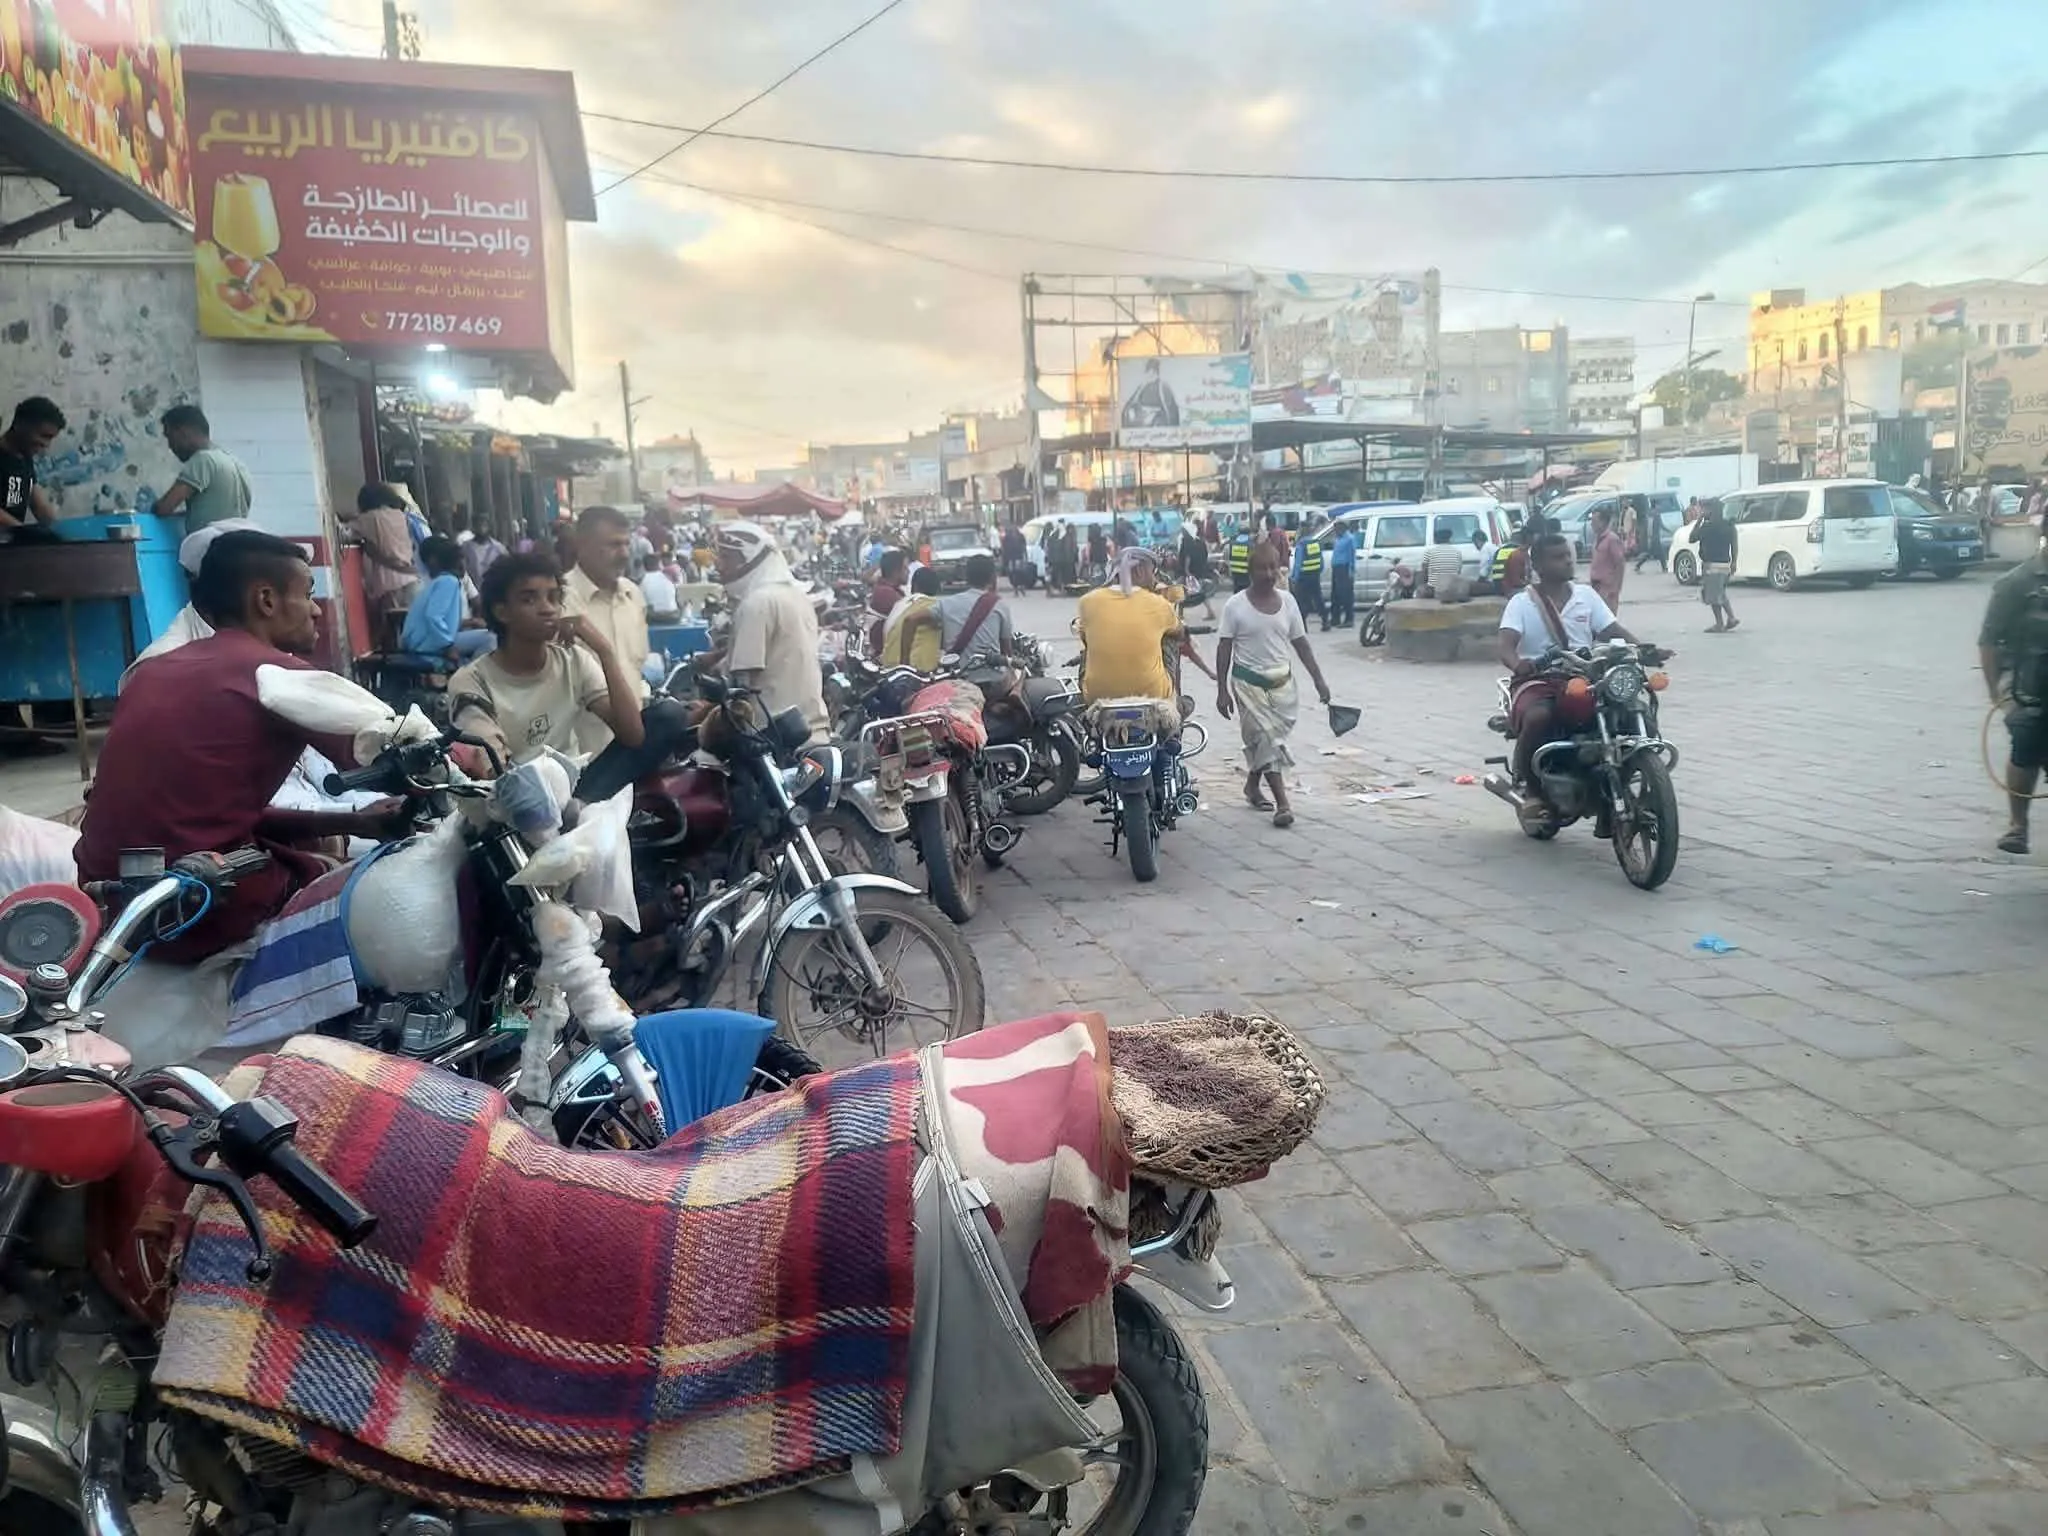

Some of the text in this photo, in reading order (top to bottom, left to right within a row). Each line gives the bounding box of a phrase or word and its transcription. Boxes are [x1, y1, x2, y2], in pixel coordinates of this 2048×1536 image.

[197, 102, 528, 167] كافتيريا الربيع
[303, 184, 529, 220] للعصائر الطازجة
[306, 216, 530, 256] والوجبات الخفيفة
[386, 311, 502, 335] 772187469
